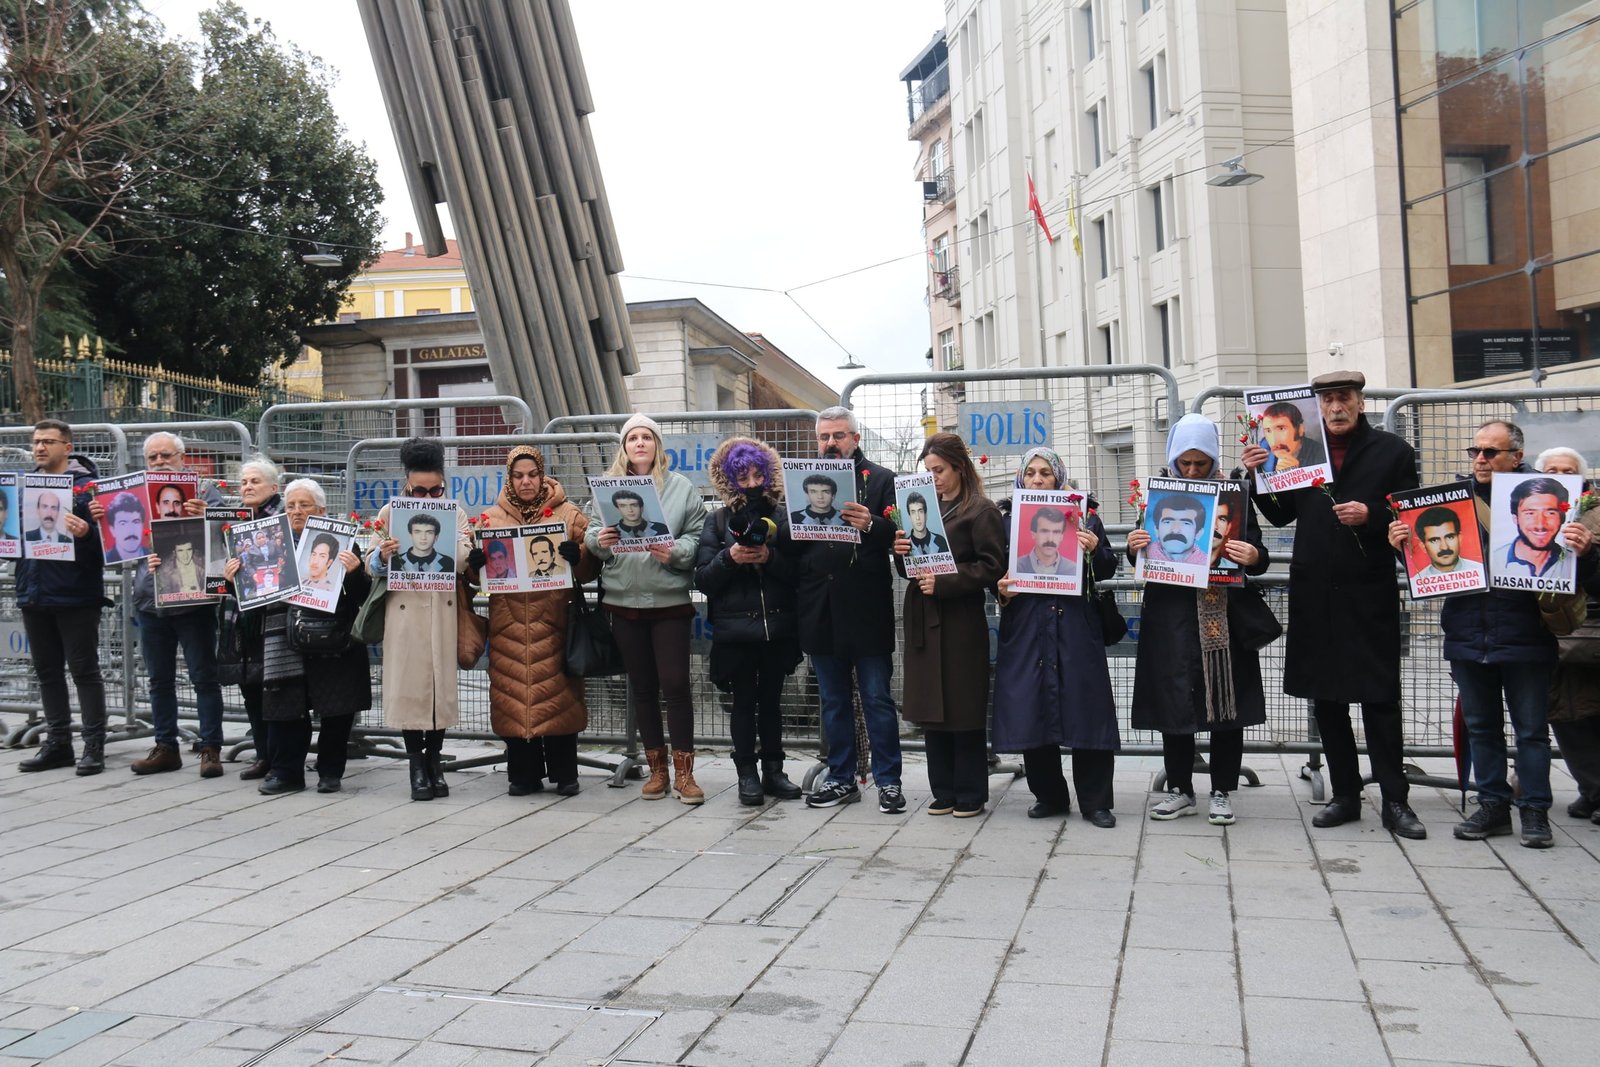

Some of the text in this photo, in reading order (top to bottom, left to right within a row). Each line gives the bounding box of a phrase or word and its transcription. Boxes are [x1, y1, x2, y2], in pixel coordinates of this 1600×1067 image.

[1274, 389, 1312, 401] KIRBAYIR
[970, 407, 1046, 446] POLİS
[783, 461, 852, 471] CÜNEYT AYDINLAR
[124, 475, 144, 490] ŞAHİN
[170, 474, 196, 482] BİLGİN
[590, 478, 654, 488] CÜNEYT AYDINLAR
[1274, 467, 1324, 490] KAYBEDİLDİ
[452, 472, 504, 507] POLİ
[1150, 478, 1216, 494] İBRAHİM DEMİR
[1021, 494, 1048, 502] FEHMİ
[1414, 494, 1444, 506] HASAN
[1444, 489, 1469, 501] KAYA
[392, 499, 456, 511] CÜNEYT AYDINLAR
[233, 518, 280, 534] KİRAZ ŞAHİN
[308, 518, 331, 530] MURAT
[401, 573, 427, 581] ŞUBAT
[1142, 570, 1194, 584] KAYBEDİLDİ
[1416, 570, 1479, 586] GÖZALTINDA
[1494, 576, 1571, 592] HASAN OCAK
[424, 582, 454, 591] KAYBEDİLDİ
[1417, 578, 1480, 594] KAYBEDİLDİ
